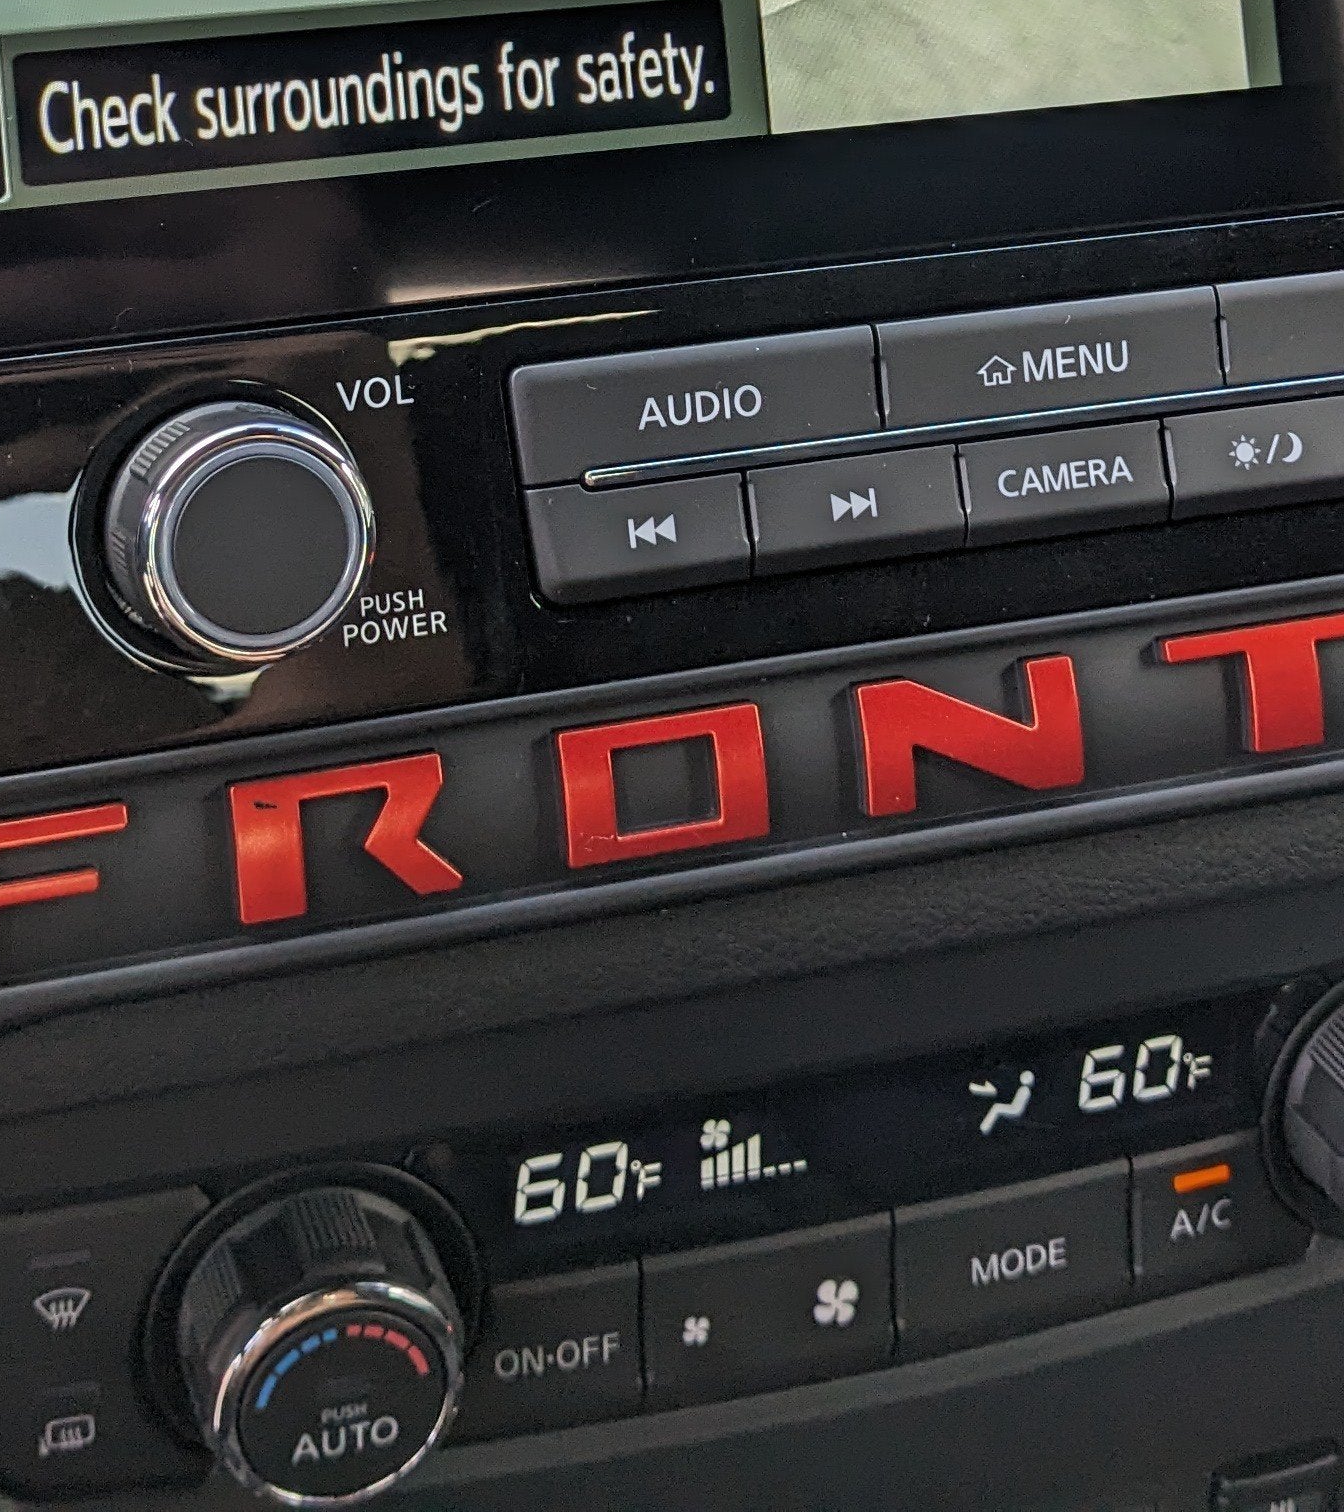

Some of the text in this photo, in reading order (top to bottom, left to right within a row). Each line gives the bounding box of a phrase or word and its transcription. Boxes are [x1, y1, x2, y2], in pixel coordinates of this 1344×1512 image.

[39, 31, 715, 154] Check surroundings for safety.
[1021, 338, 1130, 385] MENU
[336, 374, 414, 412] VOL
[638, 383, 763, 431] AUDIO
[997, 457, 1134, 501] CAMERA
[360, 588, 425, 617] PUSH
[342, 610, 449, 648] POWER
[1170, 1199, 1232, 1242] A/C
[970, 1238, 1068, 1287] MODE
[291, 1416, 399, 1466] AUTO
